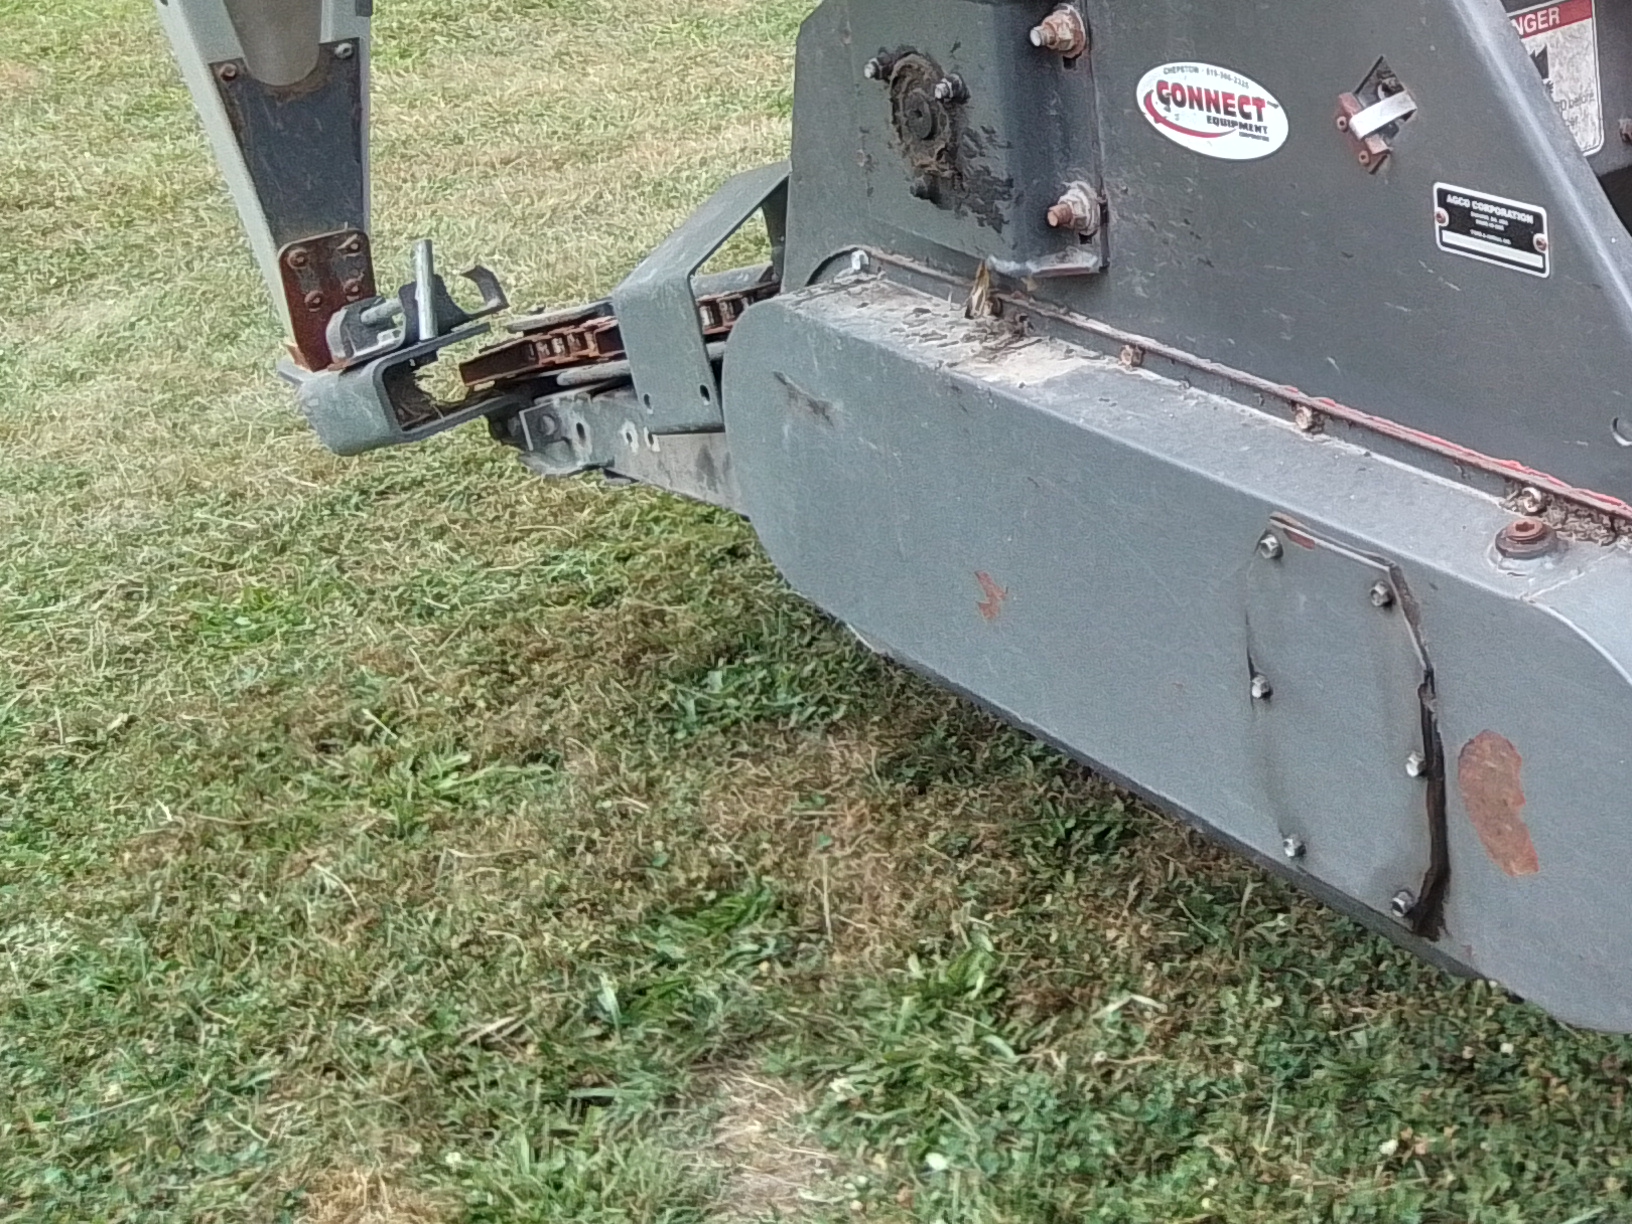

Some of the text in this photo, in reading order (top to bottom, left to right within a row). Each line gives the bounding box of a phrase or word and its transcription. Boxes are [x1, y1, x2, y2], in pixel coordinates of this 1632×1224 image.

[1510, 6, 1561, 36] NGER
[1156, 79, 1266, 123] CONNECT
[1206, 115, 1268, 135] EQUIPMENT
[1446, 193, 1471, 208] AGCO
[1471, 200, 1534, 225] CORPORATION
